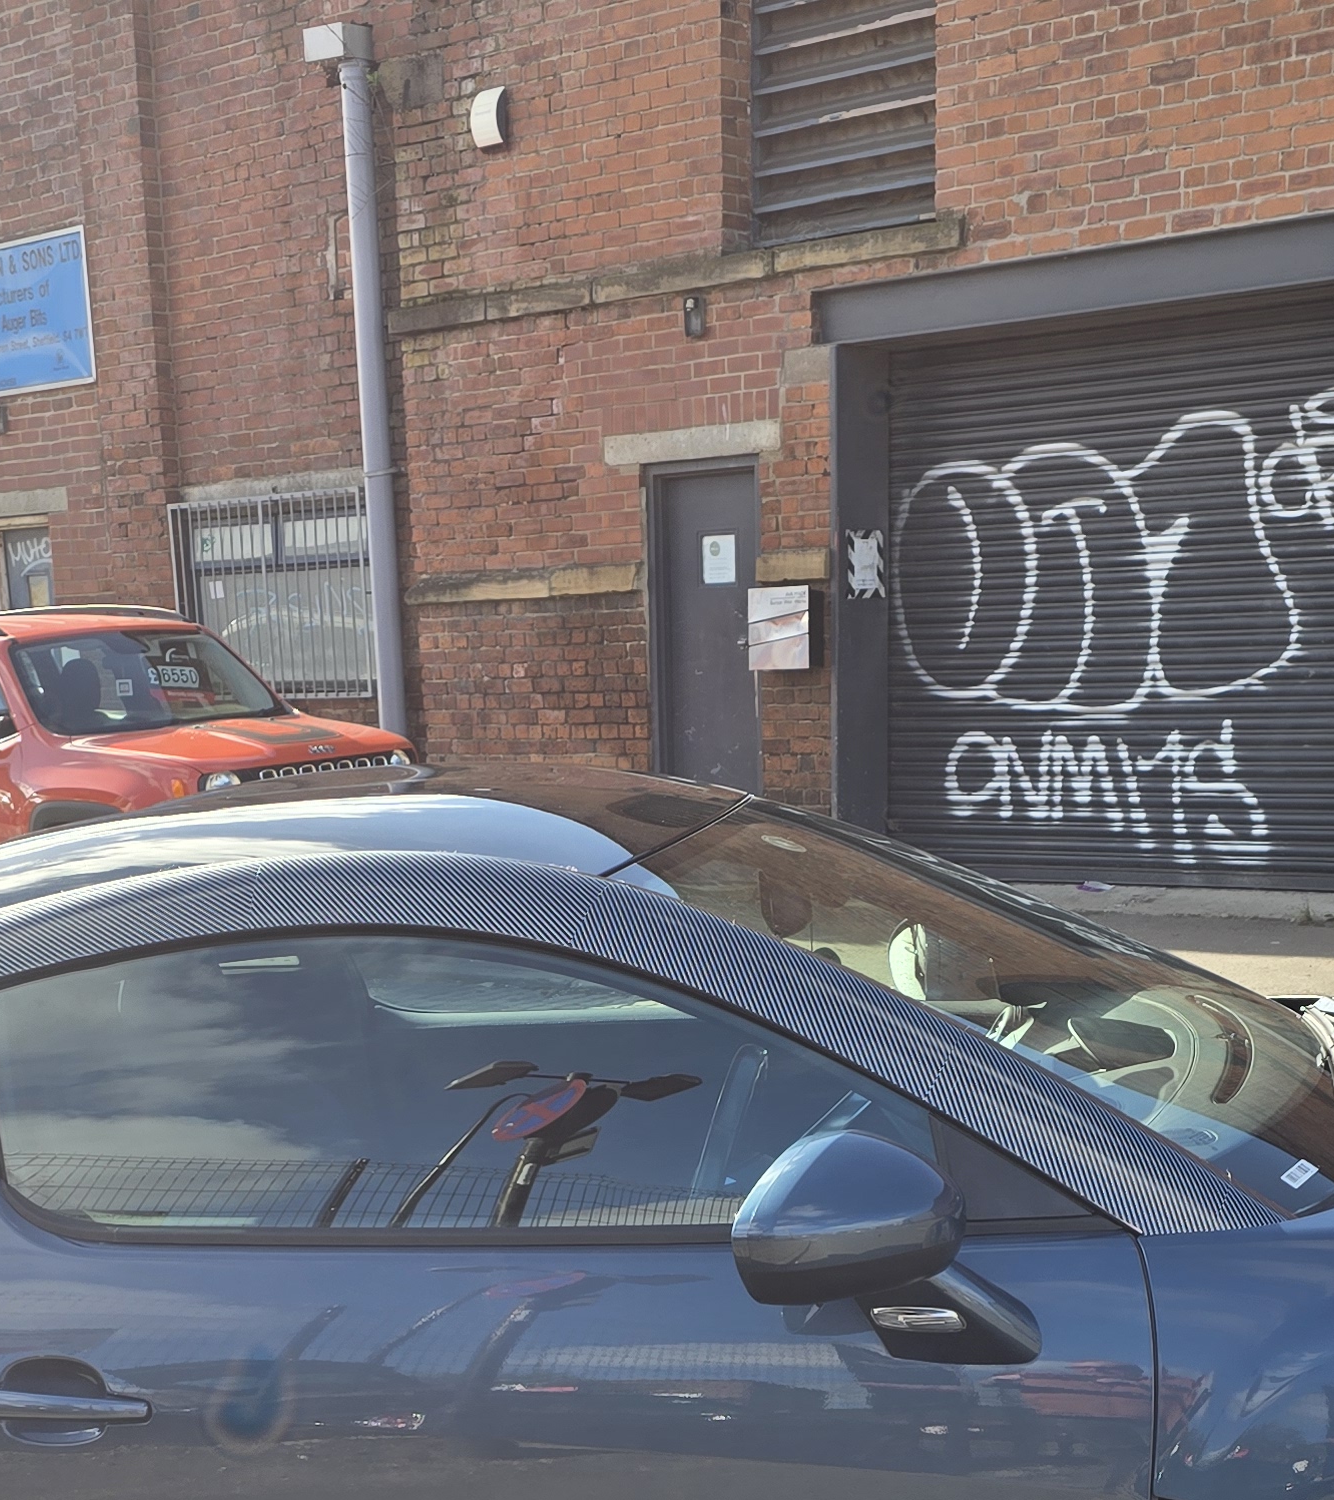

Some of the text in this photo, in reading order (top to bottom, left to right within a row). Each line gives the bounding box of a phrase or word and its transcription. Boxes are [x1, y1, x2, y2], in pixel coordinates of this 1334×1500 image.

[8, 254, 17, 274] &
[21, 245, 54, 272] SONS
[38, 279, 51, 298] of
[2, 314, 27, 335] Auger
